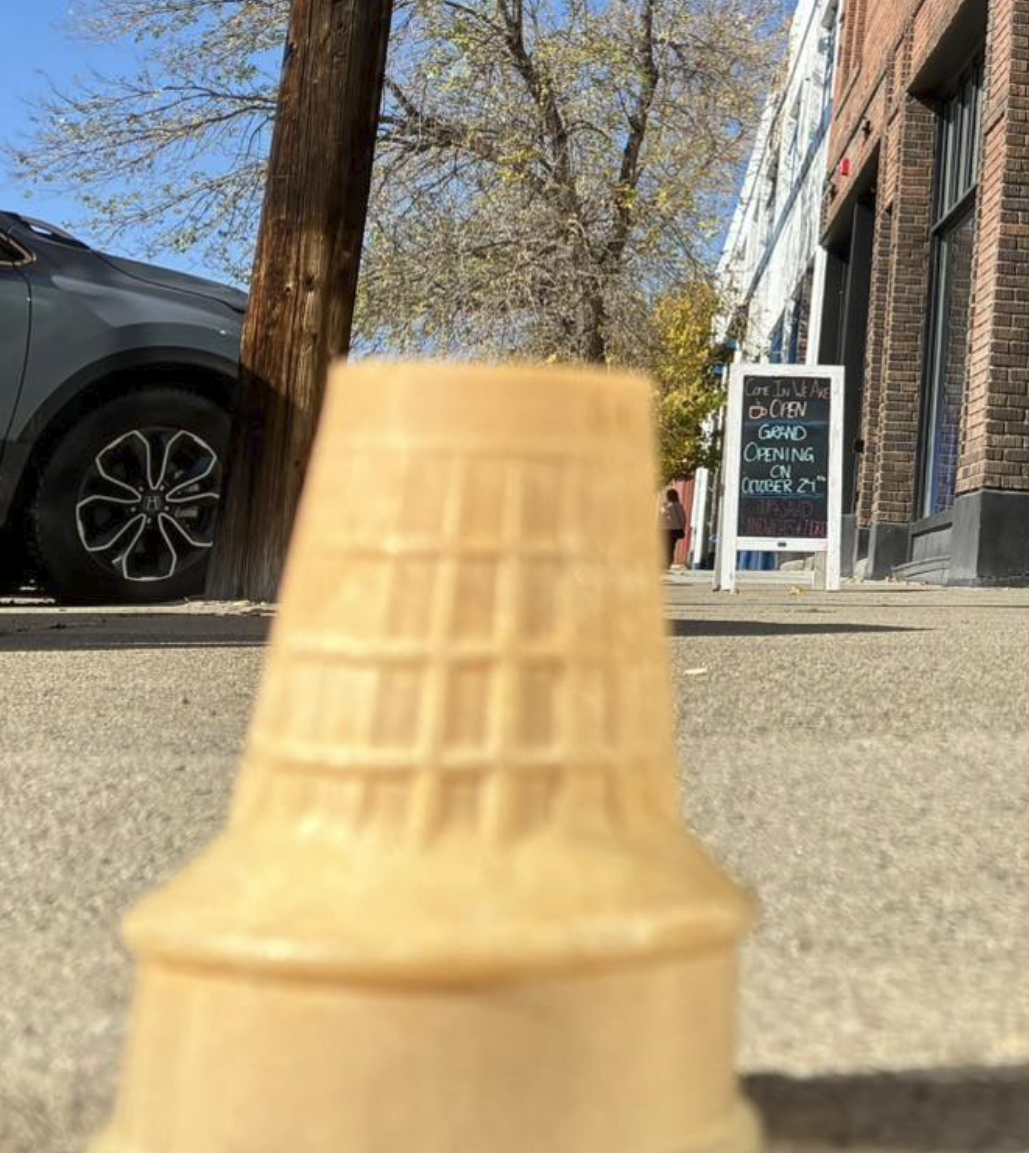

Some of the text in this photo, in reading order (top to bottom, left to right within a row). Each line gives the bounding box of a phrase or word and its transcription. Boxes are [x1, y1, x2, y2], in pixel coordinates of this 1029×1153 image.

[769, 398, 807, 419] OPEN
[758, 423, 807, 441] GRAND
[743, 441, 815, 463] OPENING
[769, 464, 791, 479] ON
[741, 476, 793, 494] OCTOBER
